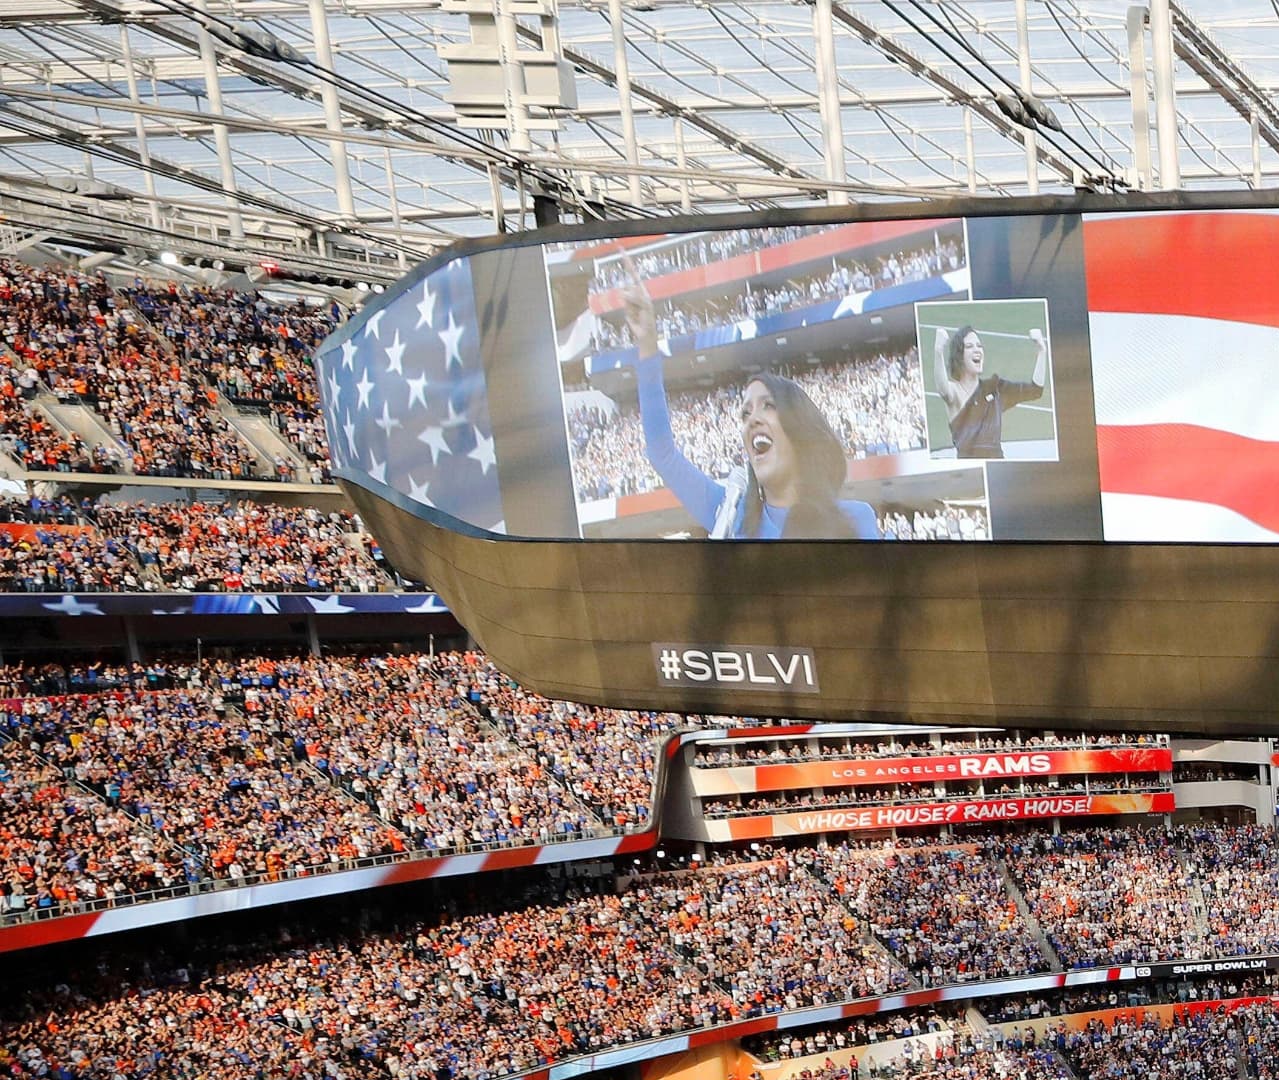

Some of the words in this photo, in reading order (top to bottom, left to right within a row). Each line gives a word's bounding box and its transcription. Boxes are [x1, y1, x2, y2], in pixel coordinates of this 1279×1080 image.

[659, 649, 815, 686] #SBLVI
[832, 768, 866, 779] LOS
[875, 763, 958, 776] ANGELES
[959, 753, 1052, 777] RAMS
[798, 811, 872, 832] WHOSE
[877, 804, 958, 825] HOUSE?
[963, 801, 1019, 820] RAMS
[1024, 796, 1093, 817] HOUSE!
[1172, 964, 1213, 974] SUPER
[1214, 961, 1250, 971] BOWL
[1250, 959, 1267, 968] LVI
